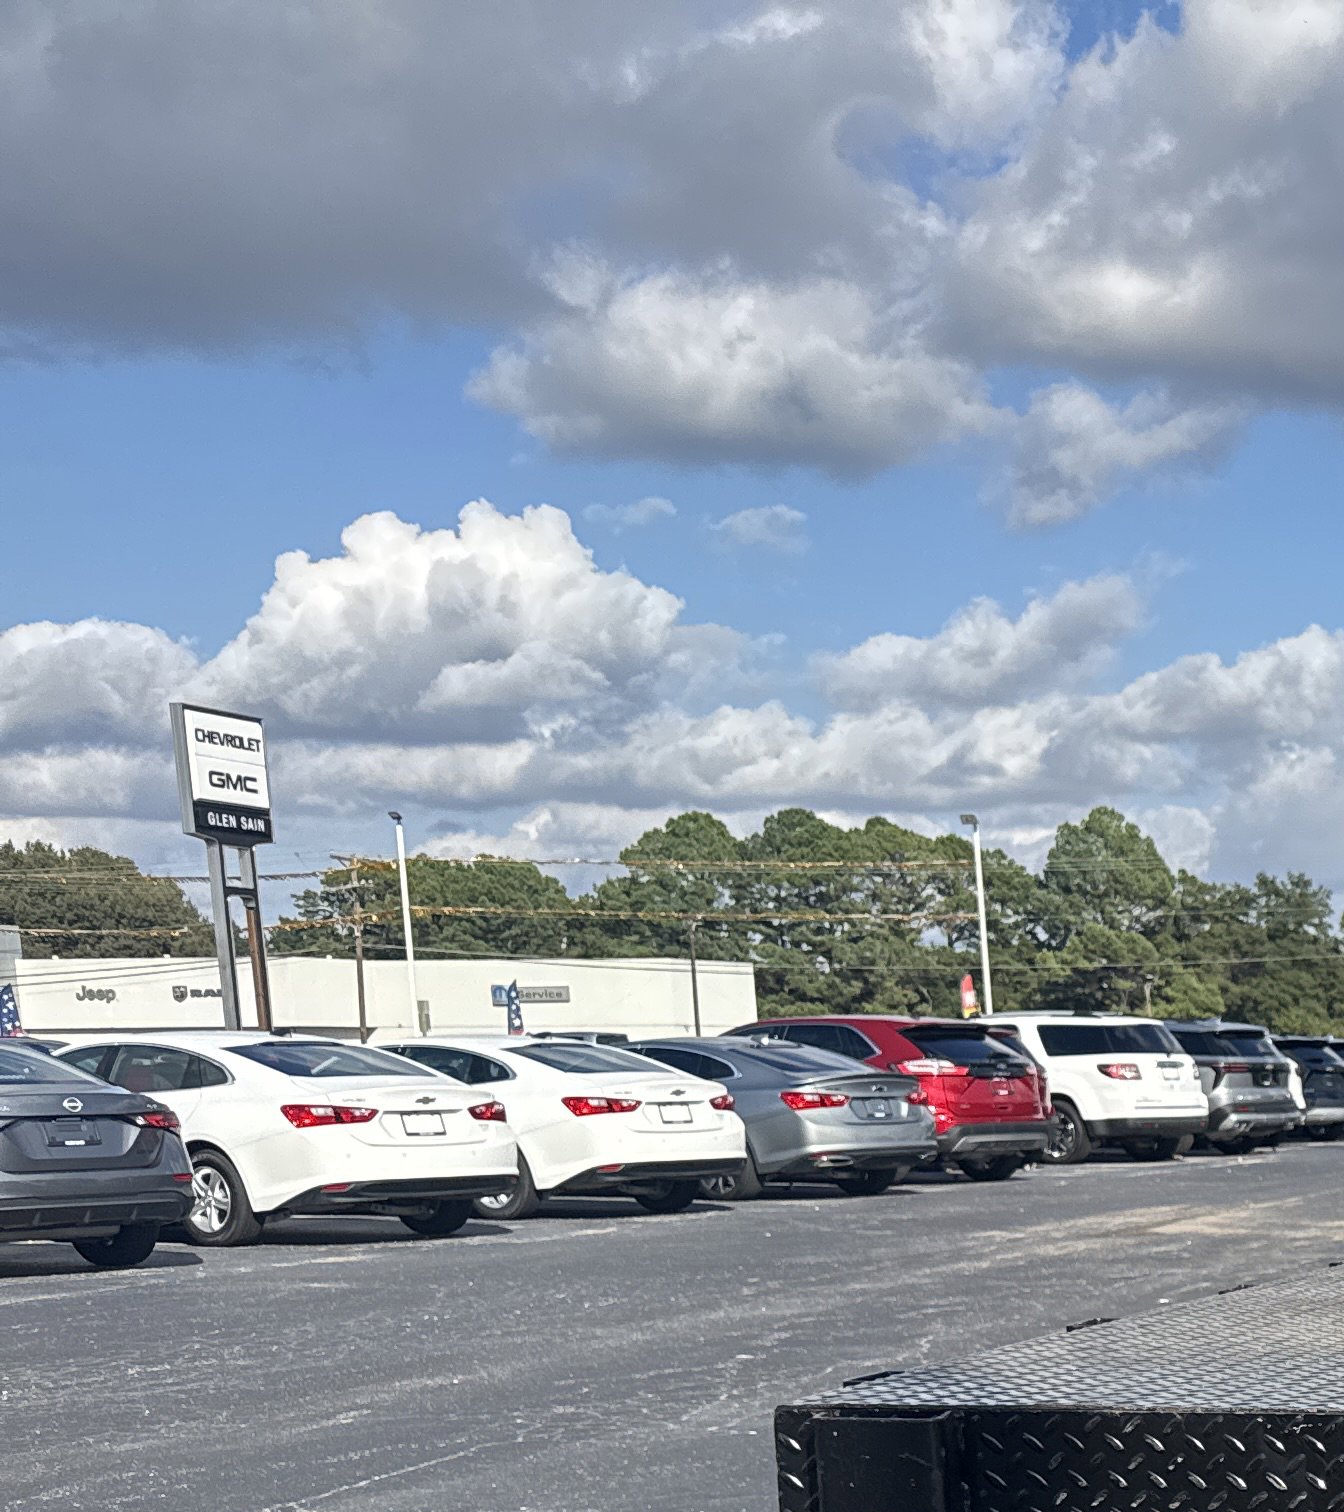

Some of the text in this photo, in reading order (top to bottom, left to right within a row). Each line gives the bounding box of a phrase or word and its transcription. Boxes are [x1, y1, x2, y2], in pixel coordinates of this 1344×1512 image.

[194, 727, 261, 752] CHEVROLET
[208, 770, 258, 794] GMC
[207, 811, 265, 832] GLEN SAIN
[75, 985, 116, 1004] Jeep
